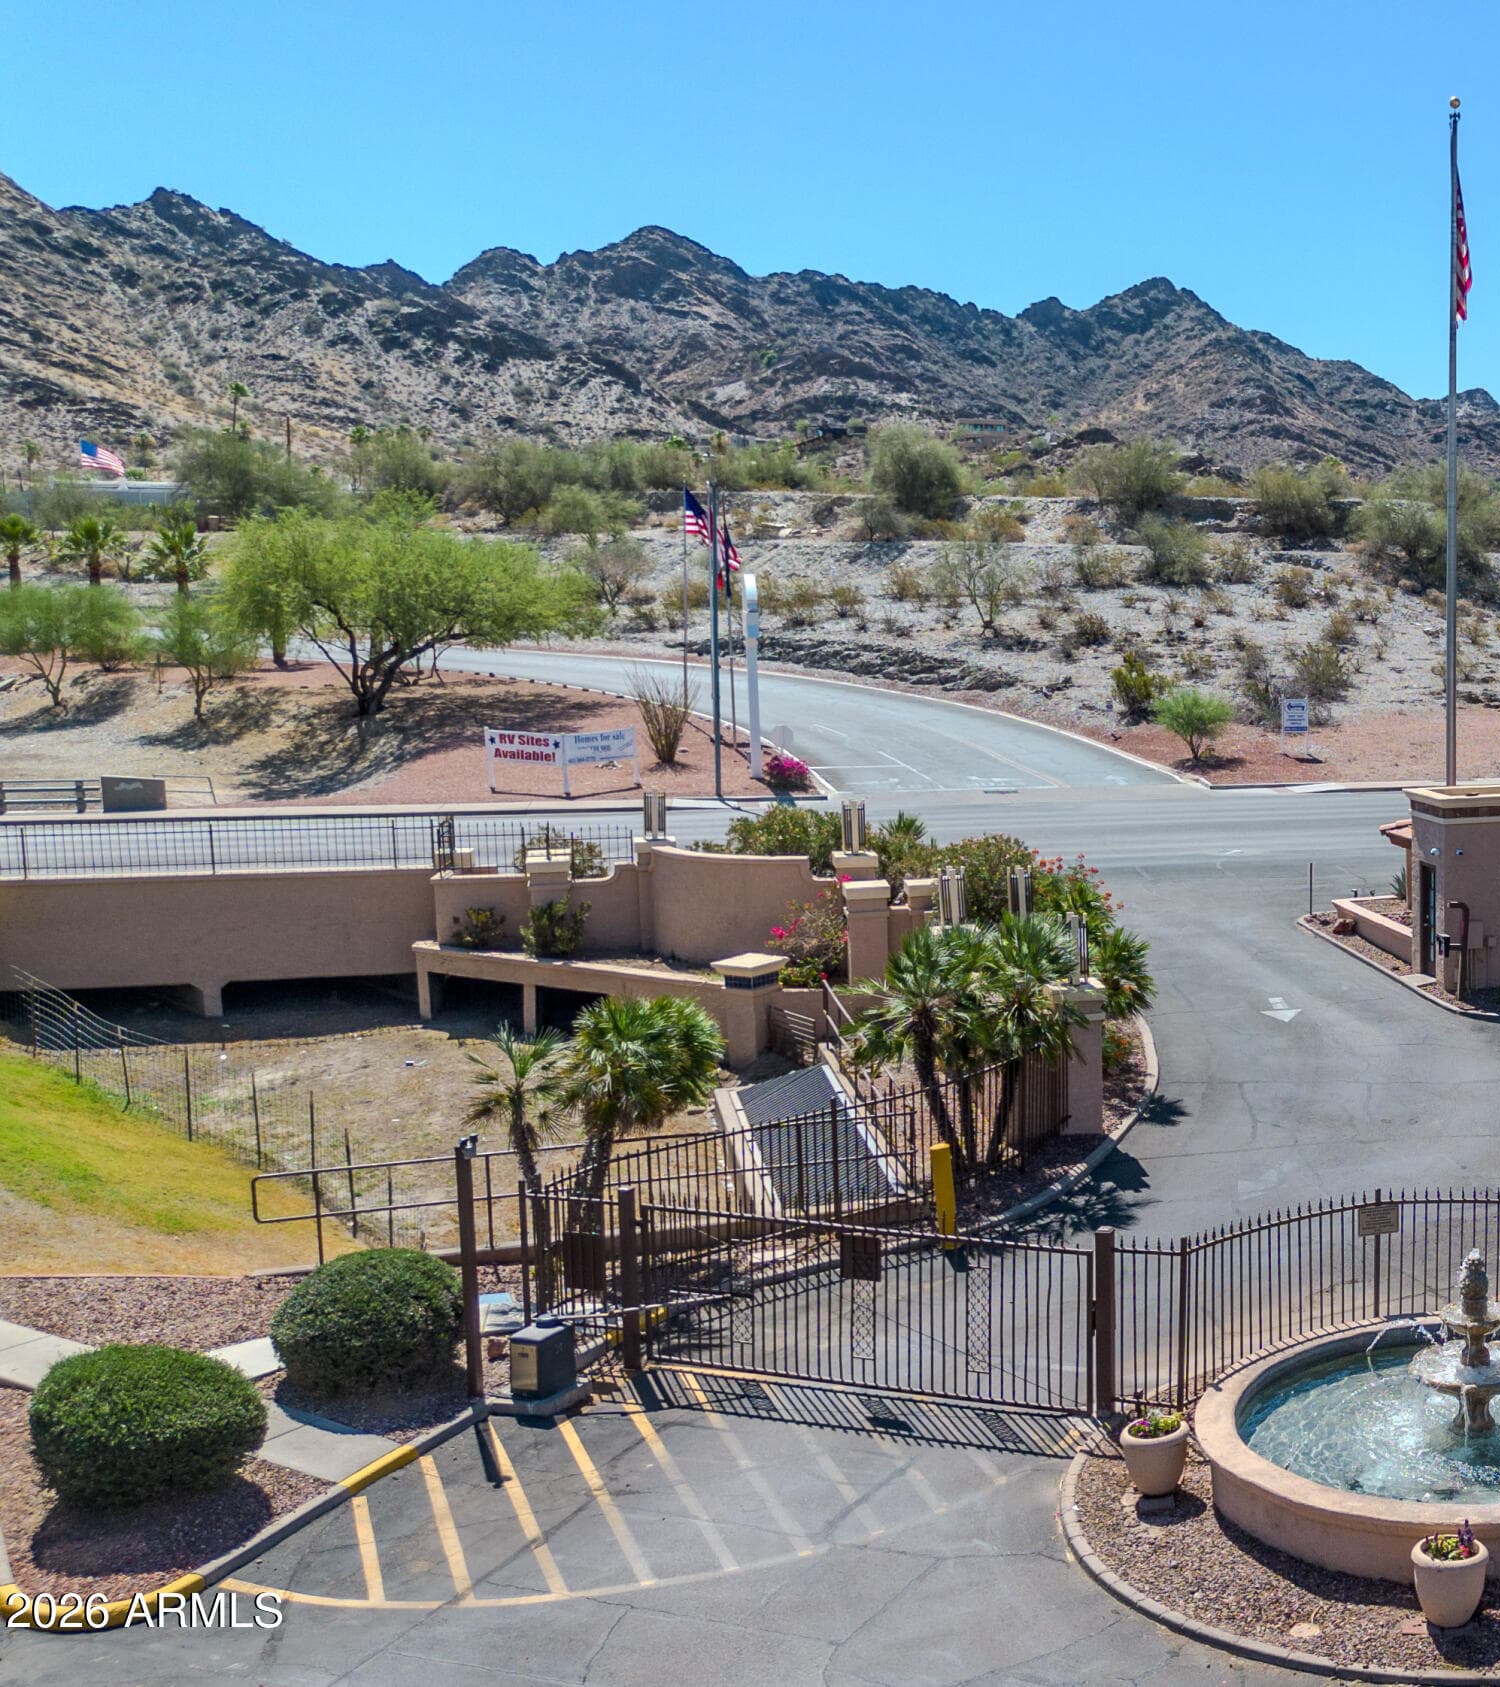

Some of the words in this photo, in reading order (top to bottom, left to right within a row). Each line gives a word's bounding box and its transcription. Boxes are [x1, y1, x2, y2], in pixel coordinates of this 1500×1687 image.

[499, 733, 516, 745] RV
[518, 734, 550, 748] Sites
[494, 747, 556, 763] Available!
